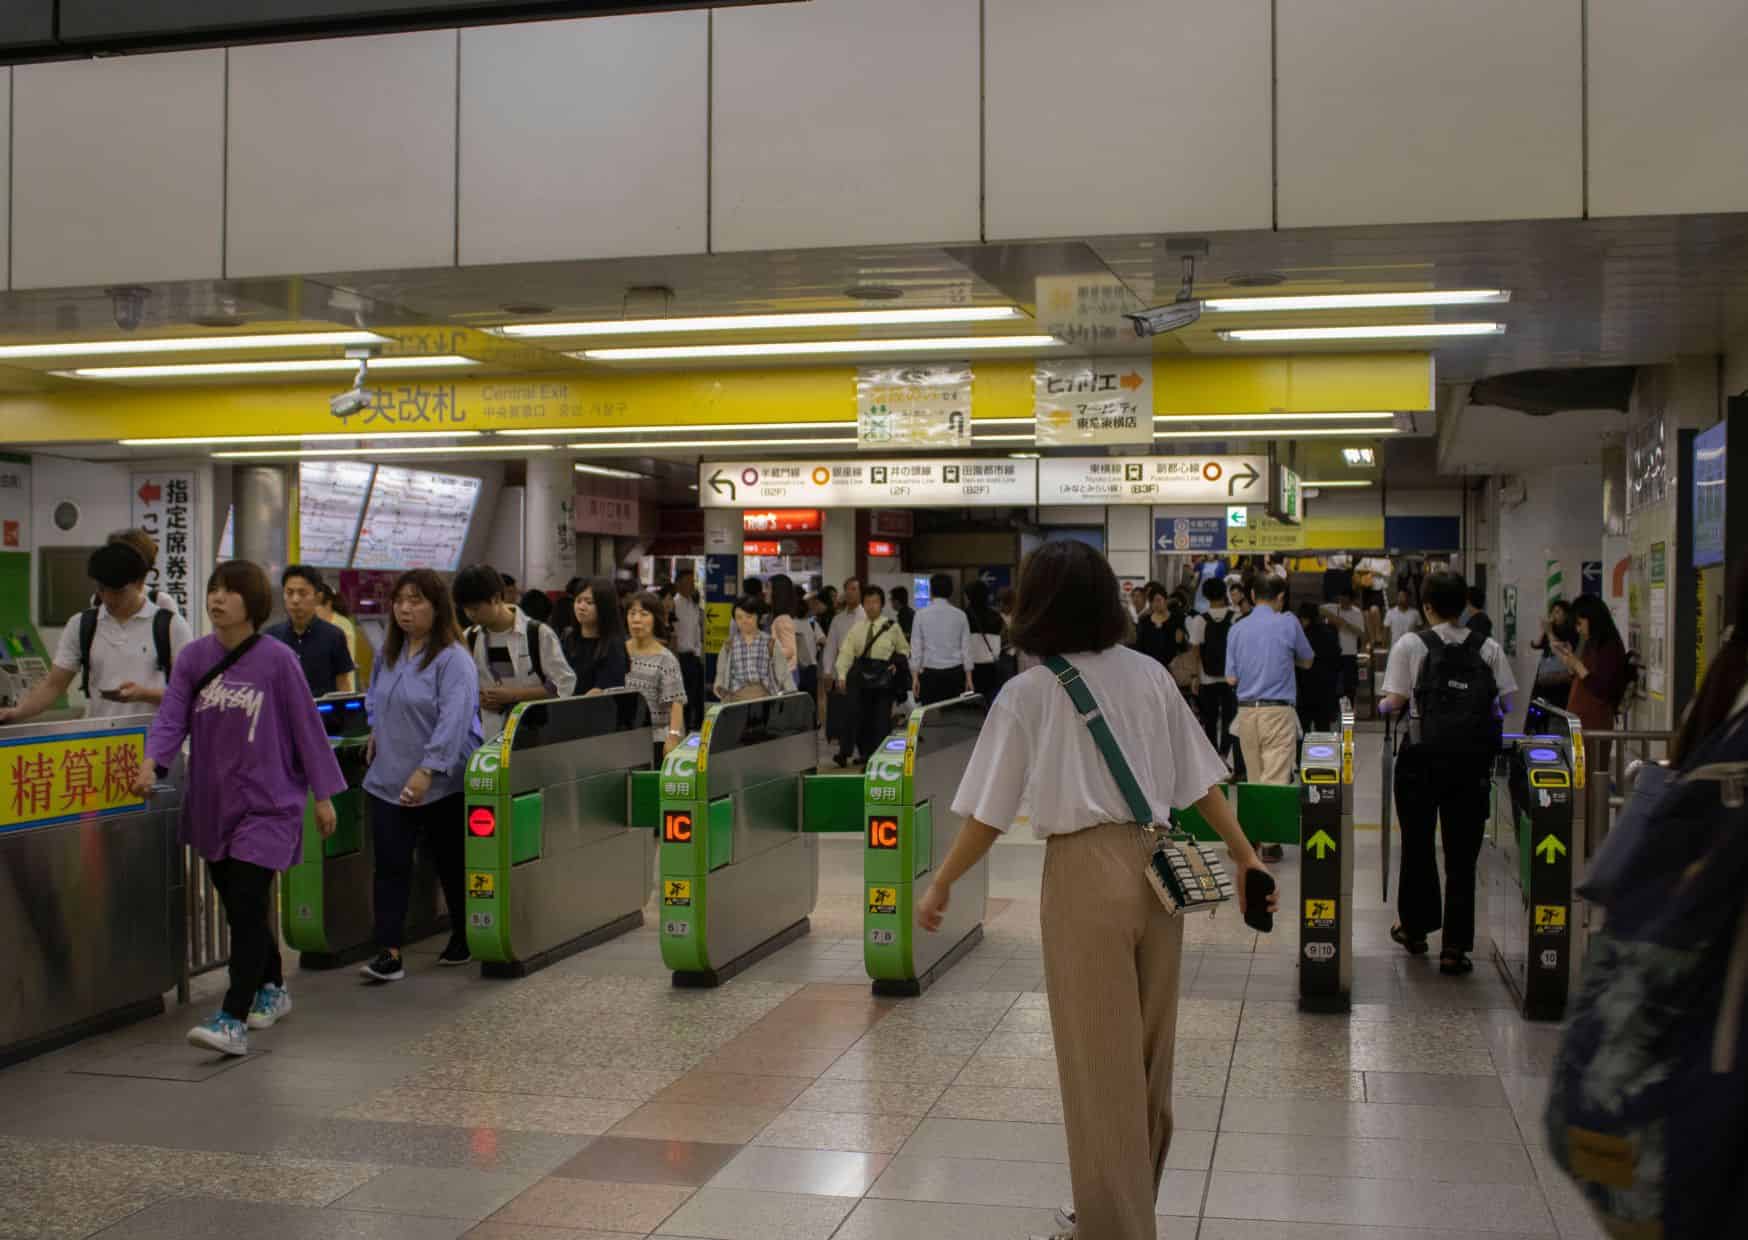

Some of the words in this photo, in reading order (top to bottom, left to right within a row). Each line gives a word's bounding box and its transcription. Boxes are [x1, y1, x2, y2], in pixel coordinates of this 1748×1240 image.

[470, 754, 500, 772] IC
[664, 757, 697, 776] IC
[868, 759, 901, 781] IC
[10, 744, 141, 816] 精算機
[666, 815, 691, 840] IC
[871, 820, 897, 847] IC
